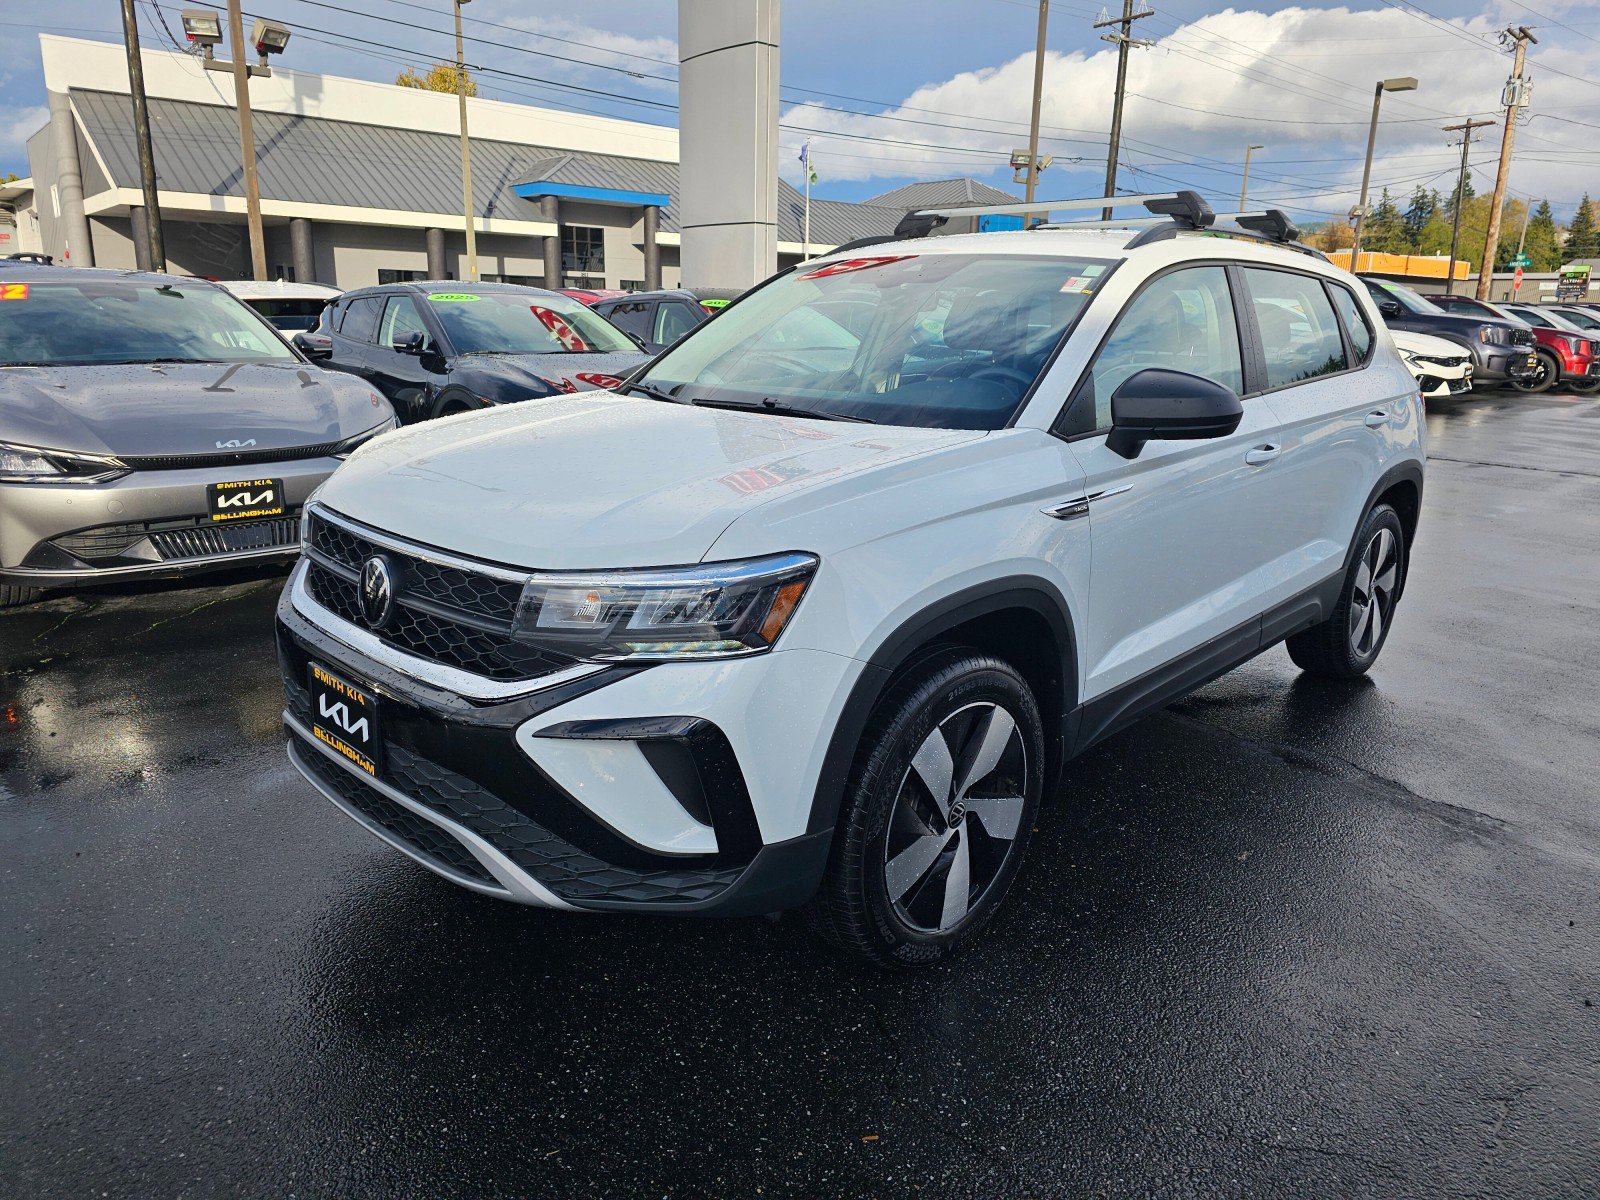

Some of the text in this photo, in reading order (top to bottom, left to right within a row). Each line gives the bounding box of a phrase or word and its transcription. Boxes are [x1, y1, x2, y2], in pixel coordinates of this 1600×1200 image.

[216, 481, 251, 490] SMITH
[212, 507, 282, 521] BELLINGHAM
[313, 667, 365, 706] SMITH KIA
[313, 725, 375, 776] BELLINGHAM
